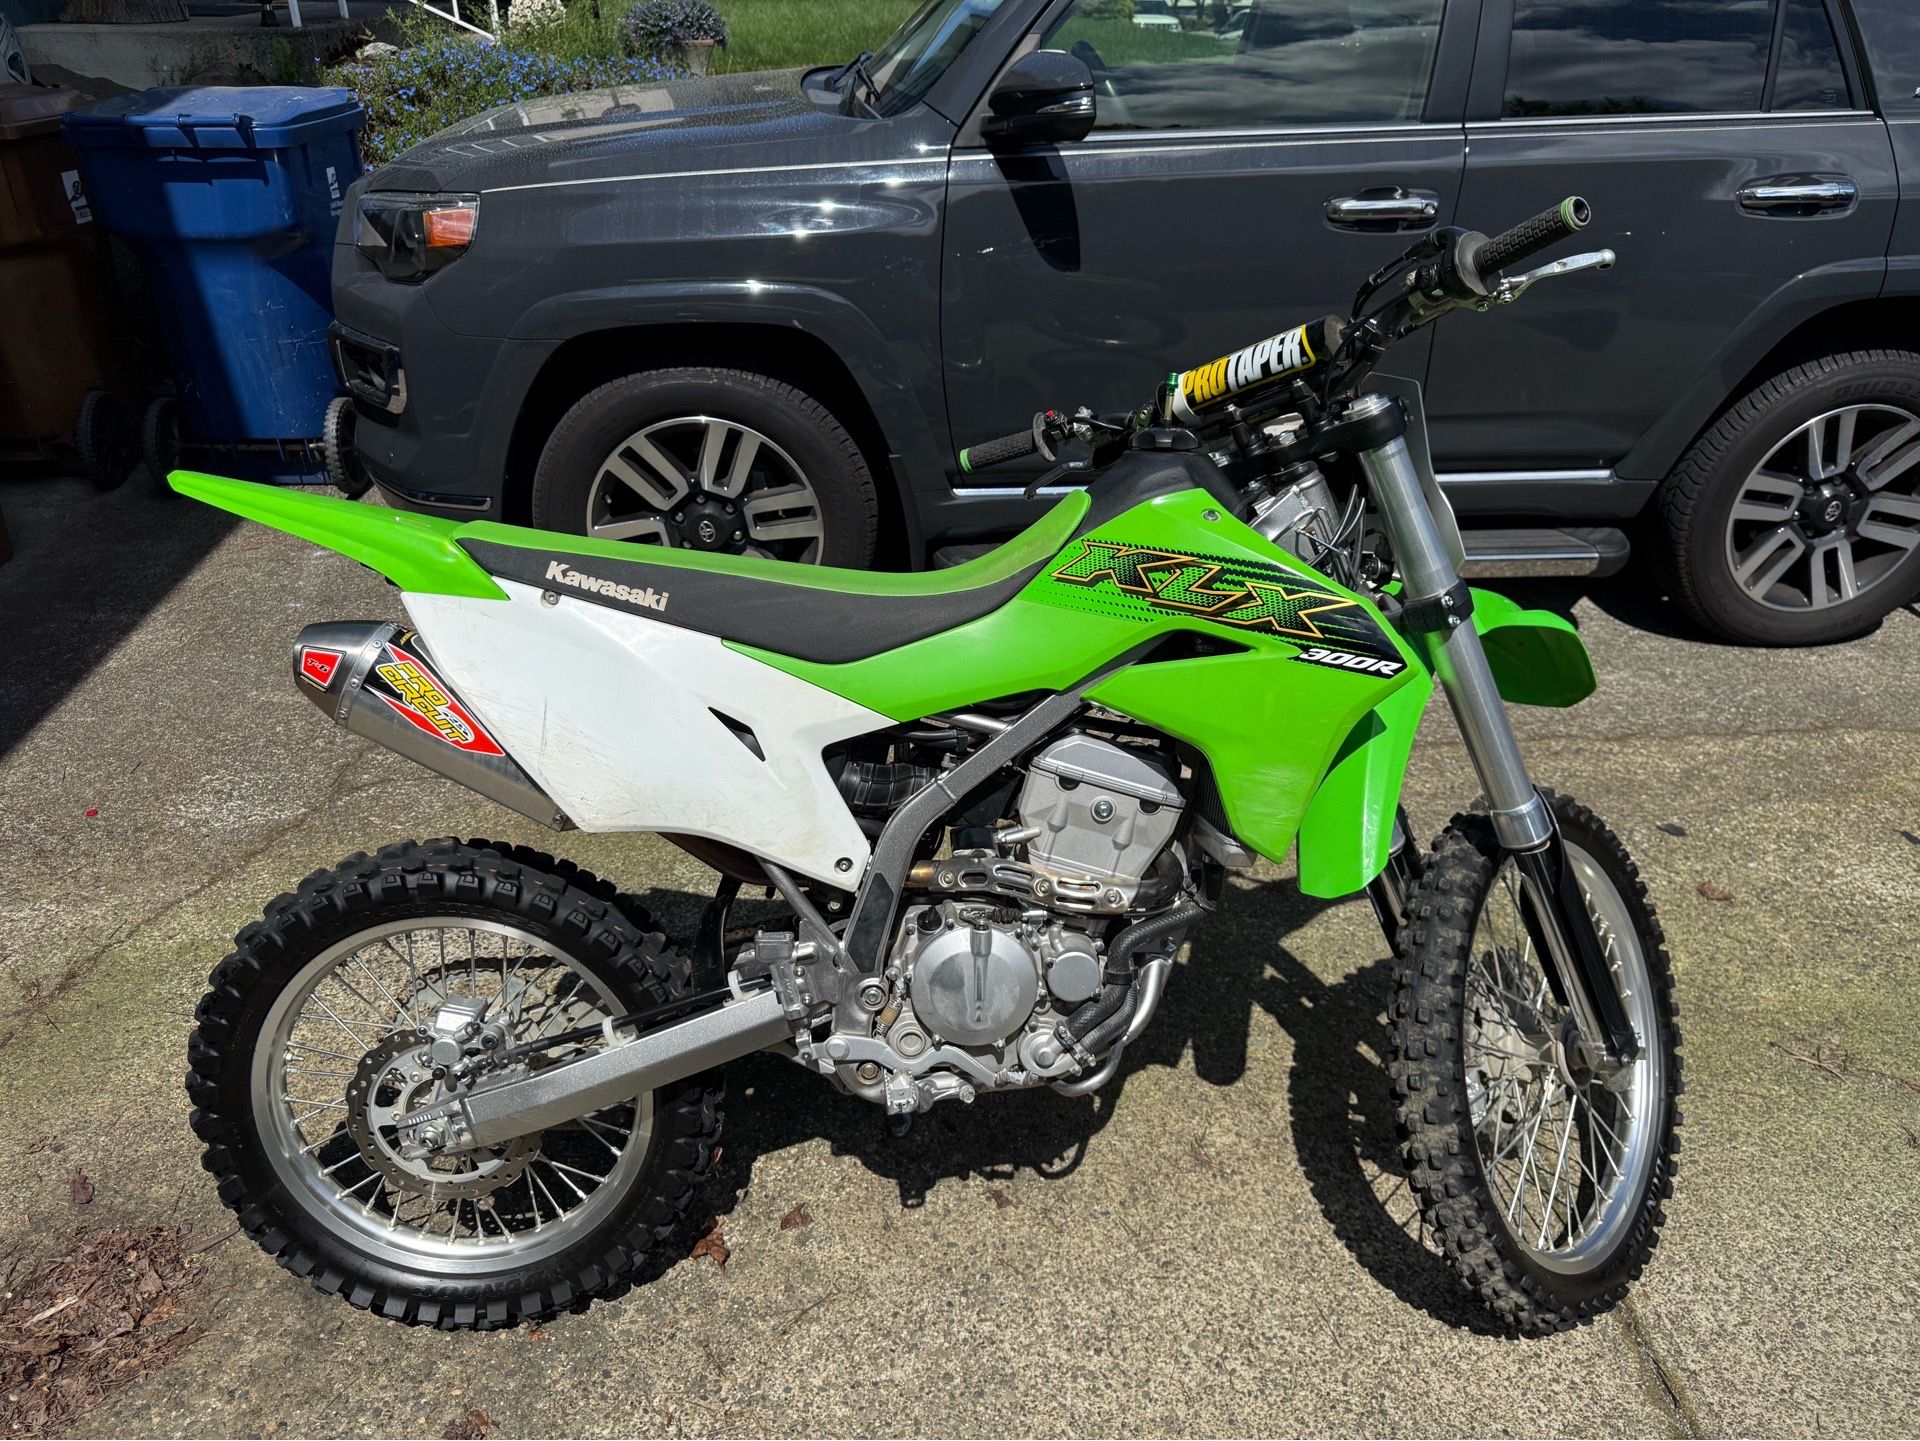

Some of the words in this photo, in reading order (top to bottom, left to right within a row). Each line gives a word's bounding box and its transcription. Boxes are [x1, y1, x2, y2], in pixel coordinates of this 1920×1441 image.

[545, 560, 670, 612] Kawasaki
[1051, 541, 1357, 638] KLX
[395, 661, 450, 708] PRO
[1299, 648, 1403, 675] 300R
[378, 665, 469, 743] CIRCUIT
